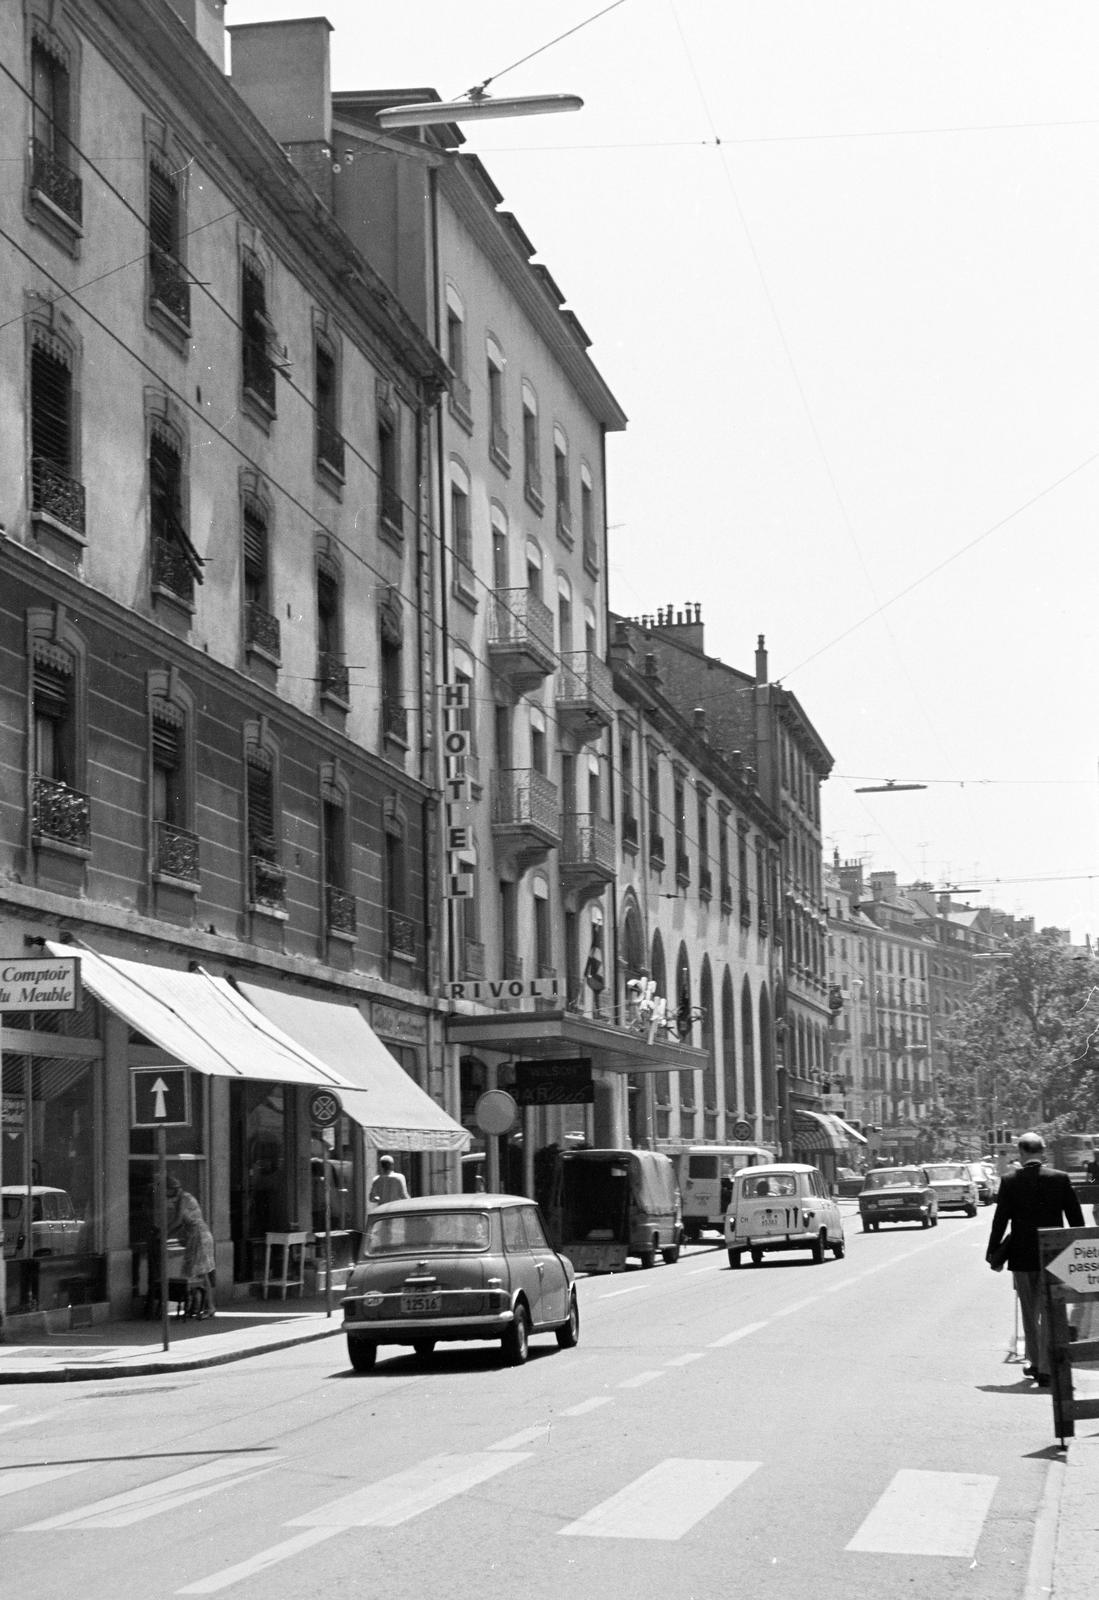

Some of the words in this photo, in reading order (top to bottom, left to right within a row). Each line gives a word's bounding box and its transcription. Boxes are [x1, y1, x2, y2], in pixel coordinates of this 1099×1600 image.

[446, 685, 467, 896] HOTEL
[2, 966, 70, 985] Comptoir
[17, 986, 72, 1003] Meuble
[451, 980, 558, 999] RIVOLI
[1074, 1246, 1099, 1259] Piét
[1069, 1262, 1099, 1275] pass
